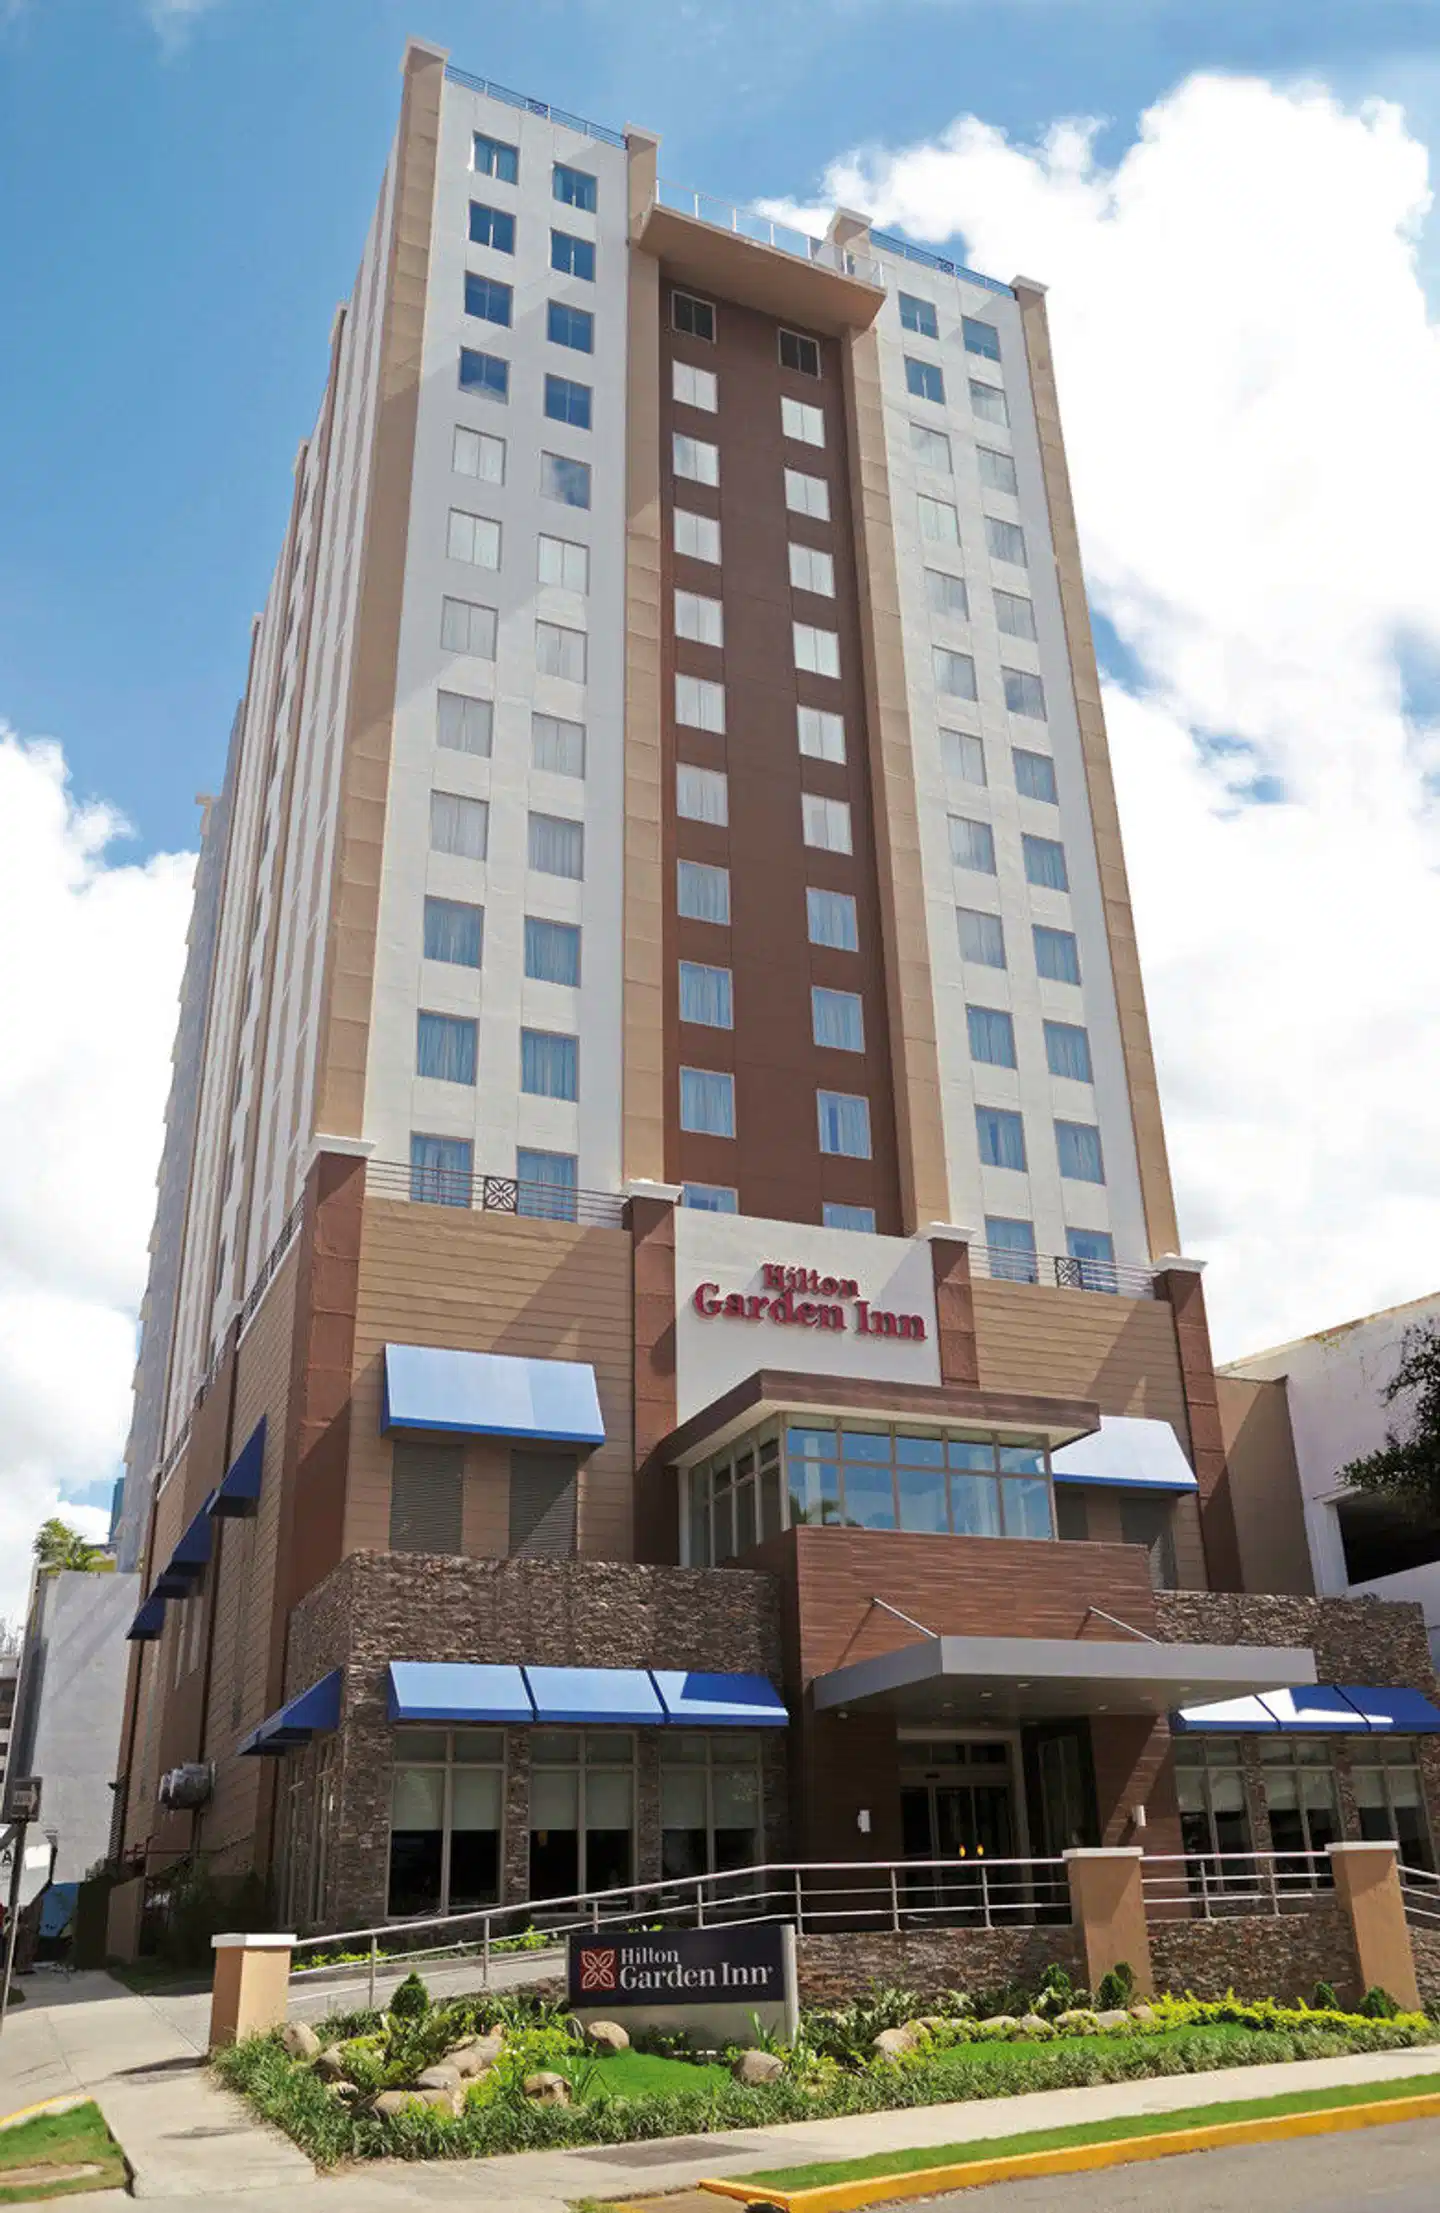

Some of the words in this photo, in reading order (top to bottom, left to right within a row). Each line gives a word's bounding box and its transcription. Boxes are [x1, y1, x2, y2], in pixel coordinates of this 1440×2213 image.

[762, 1263, 860, 1297] Hilton
[694, 1282, 847, 1330] Garden
[854, 1300, 928, 1341] Inn
[621, 1948, 679, 1964] Hilton
[619, 1963, 716, 1990] Garden
